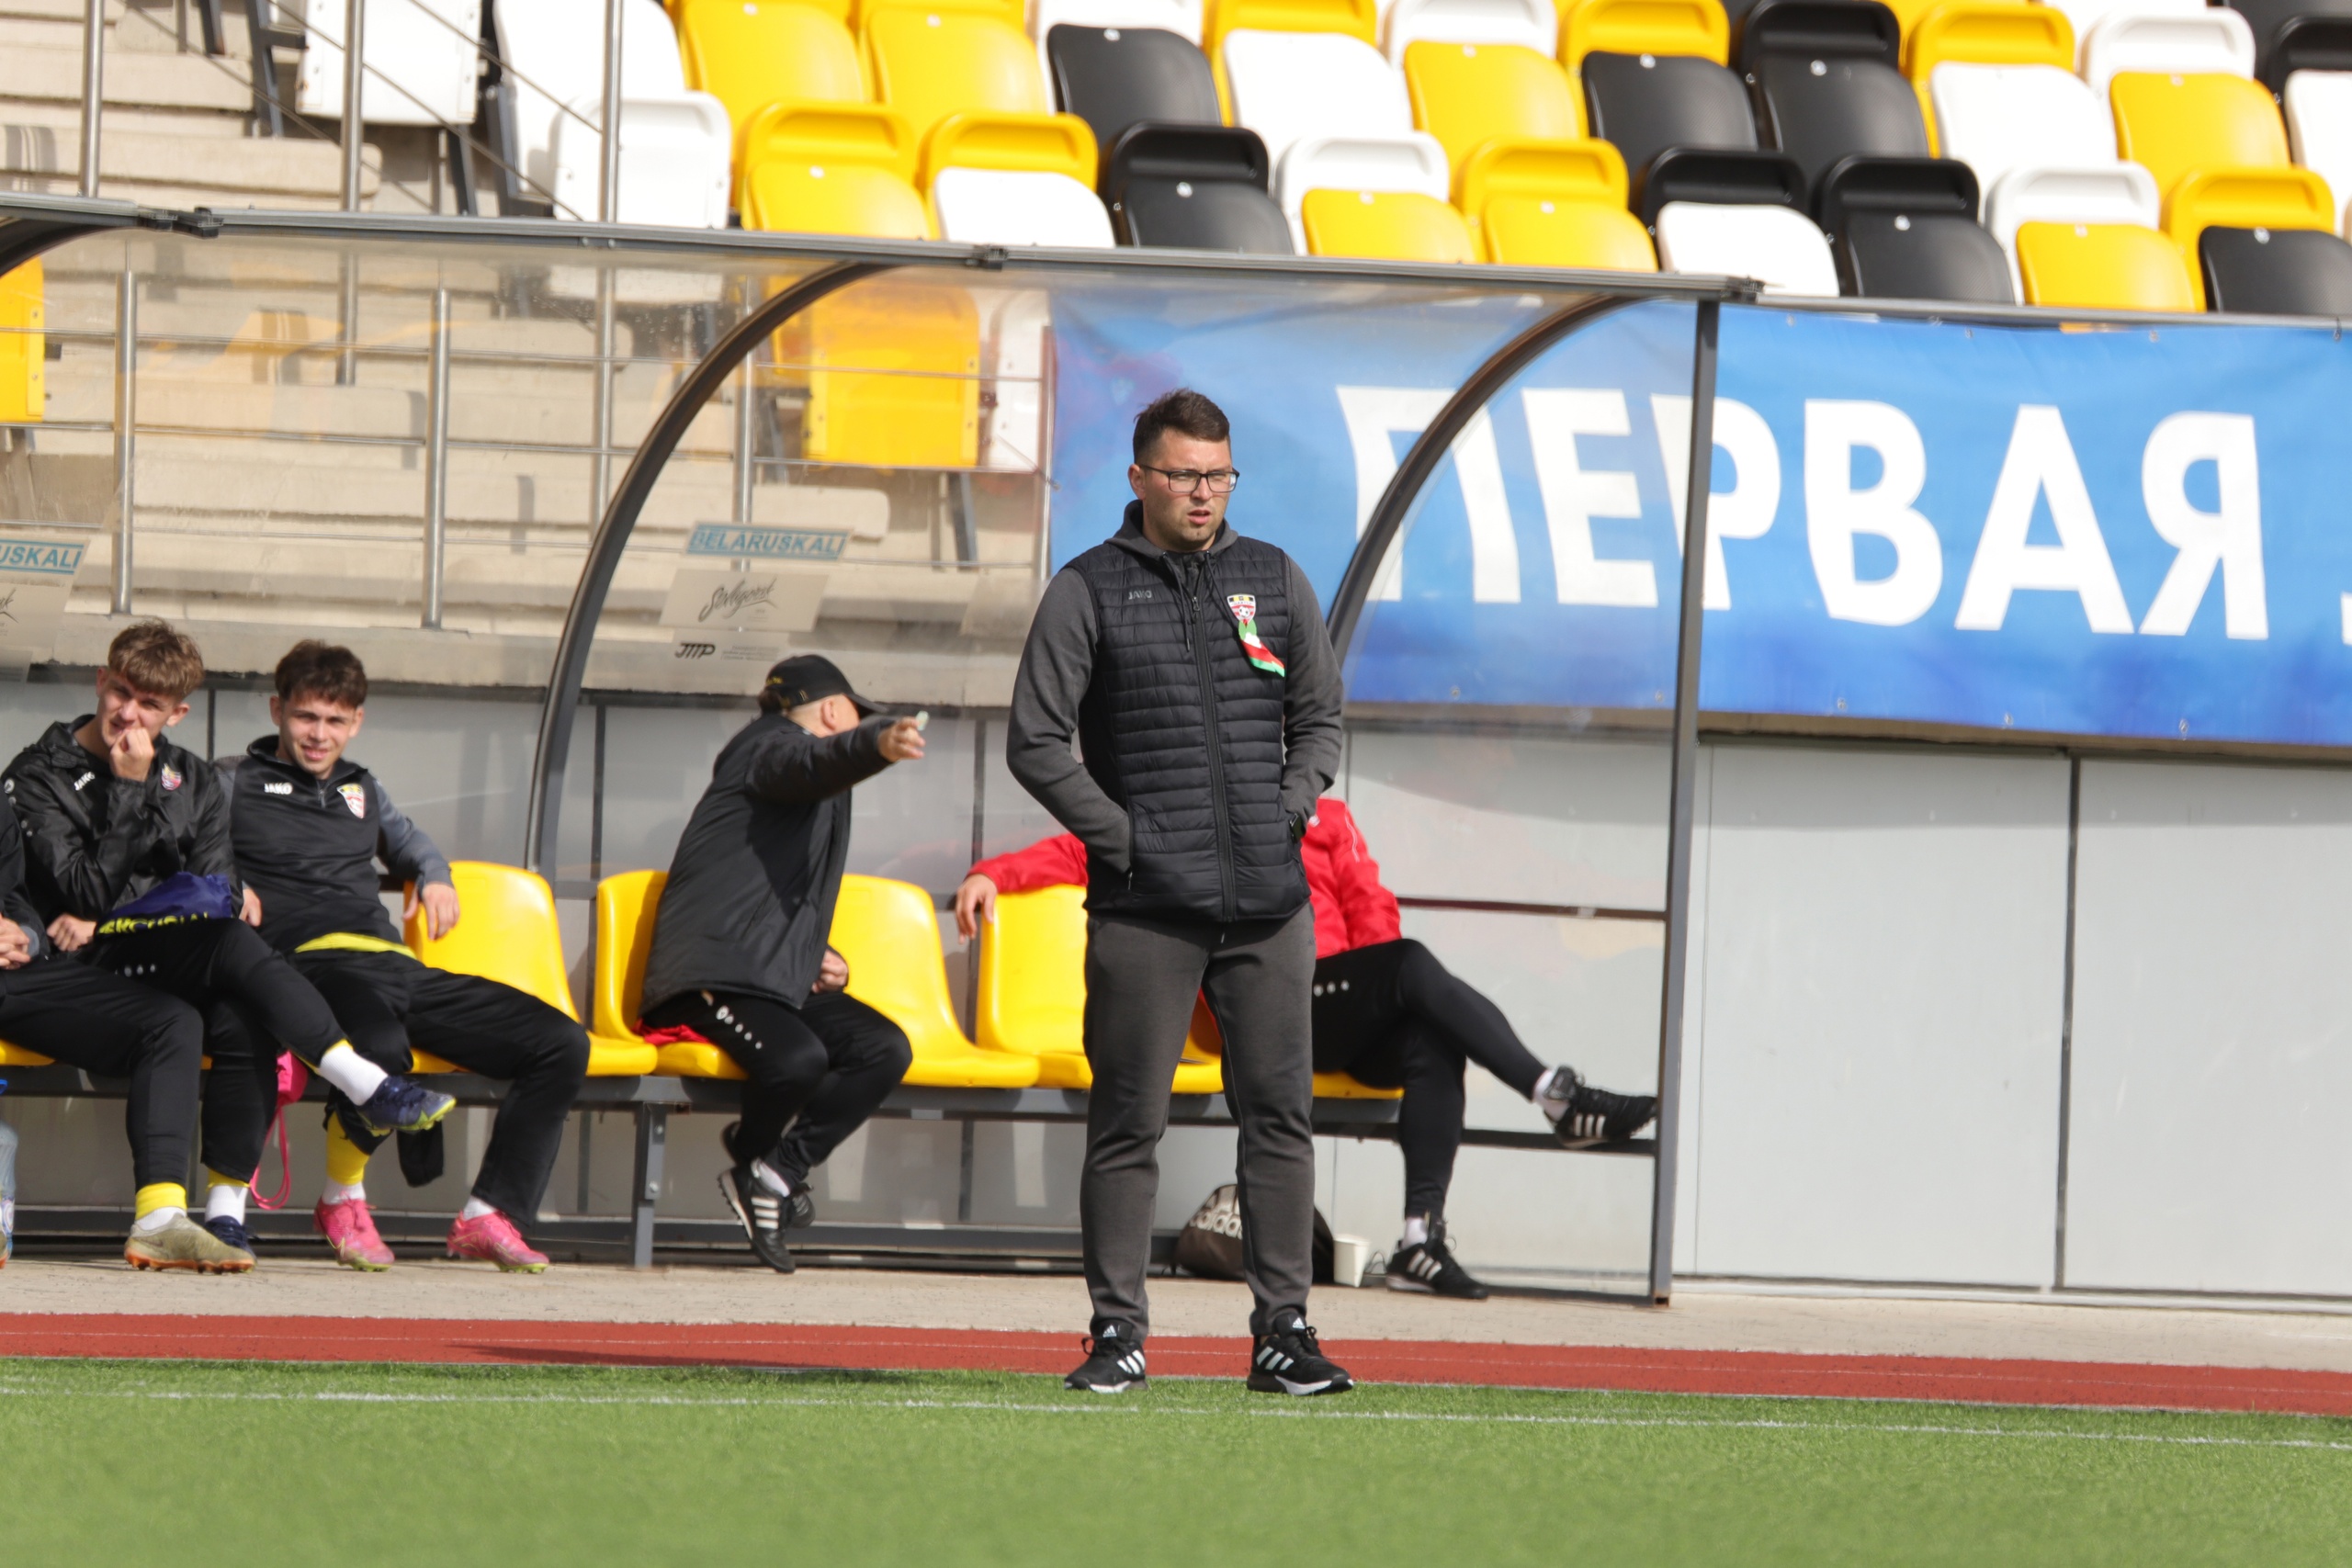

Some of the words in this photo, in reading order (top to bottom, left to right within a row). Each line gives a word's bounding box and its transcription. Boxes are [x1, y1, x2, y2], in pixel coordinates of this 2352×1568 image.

[1337, 386, 2269, 641] ПЕРВАЯ
[690, 529, 846, 558] BELARUSKALI
[1128, 590, 1152, 600] JAKO
[1189, 1210, 1243, 1240] dida
